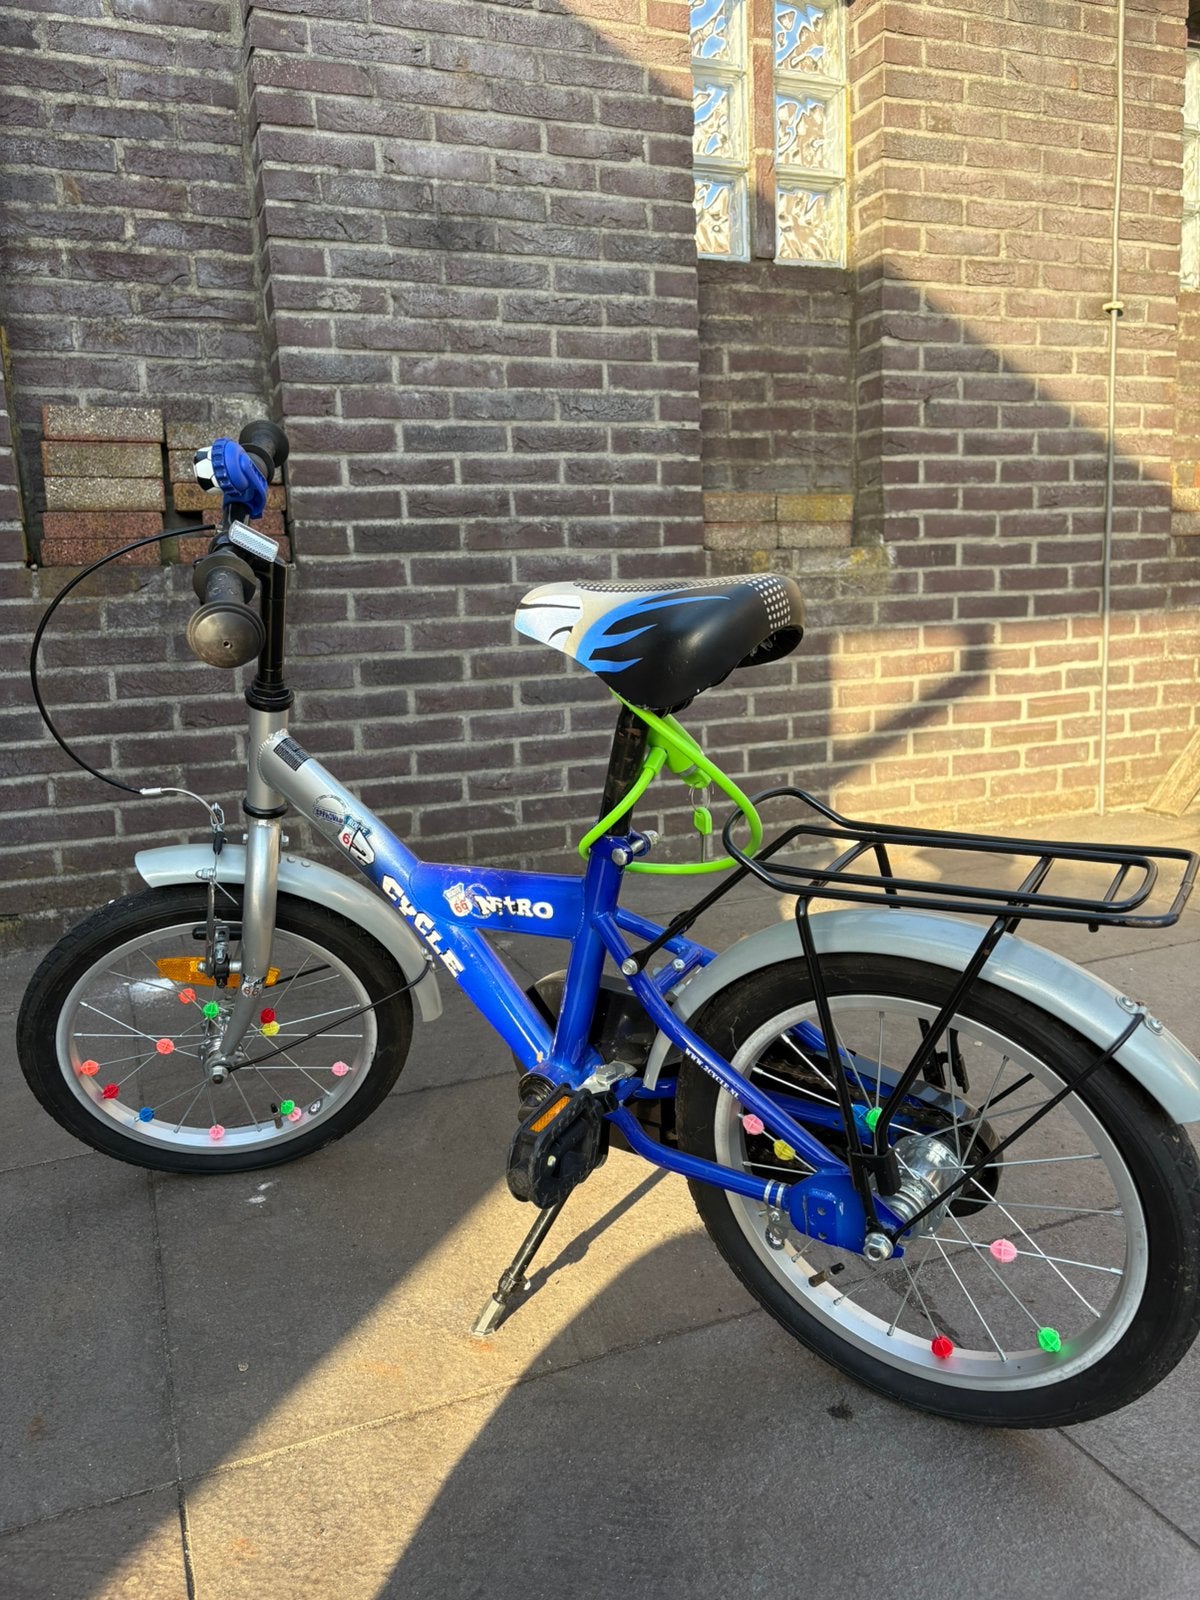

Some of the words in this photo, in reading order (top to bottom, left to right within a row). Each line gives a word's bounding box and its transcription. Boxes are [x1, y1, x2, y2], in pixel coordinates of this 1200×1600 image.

[382, 873, 466, 978] CYCLE
[453, 899, 469, 914] 66
[685, 1047, 740, 1100] WWW.2CYCLE.NL
